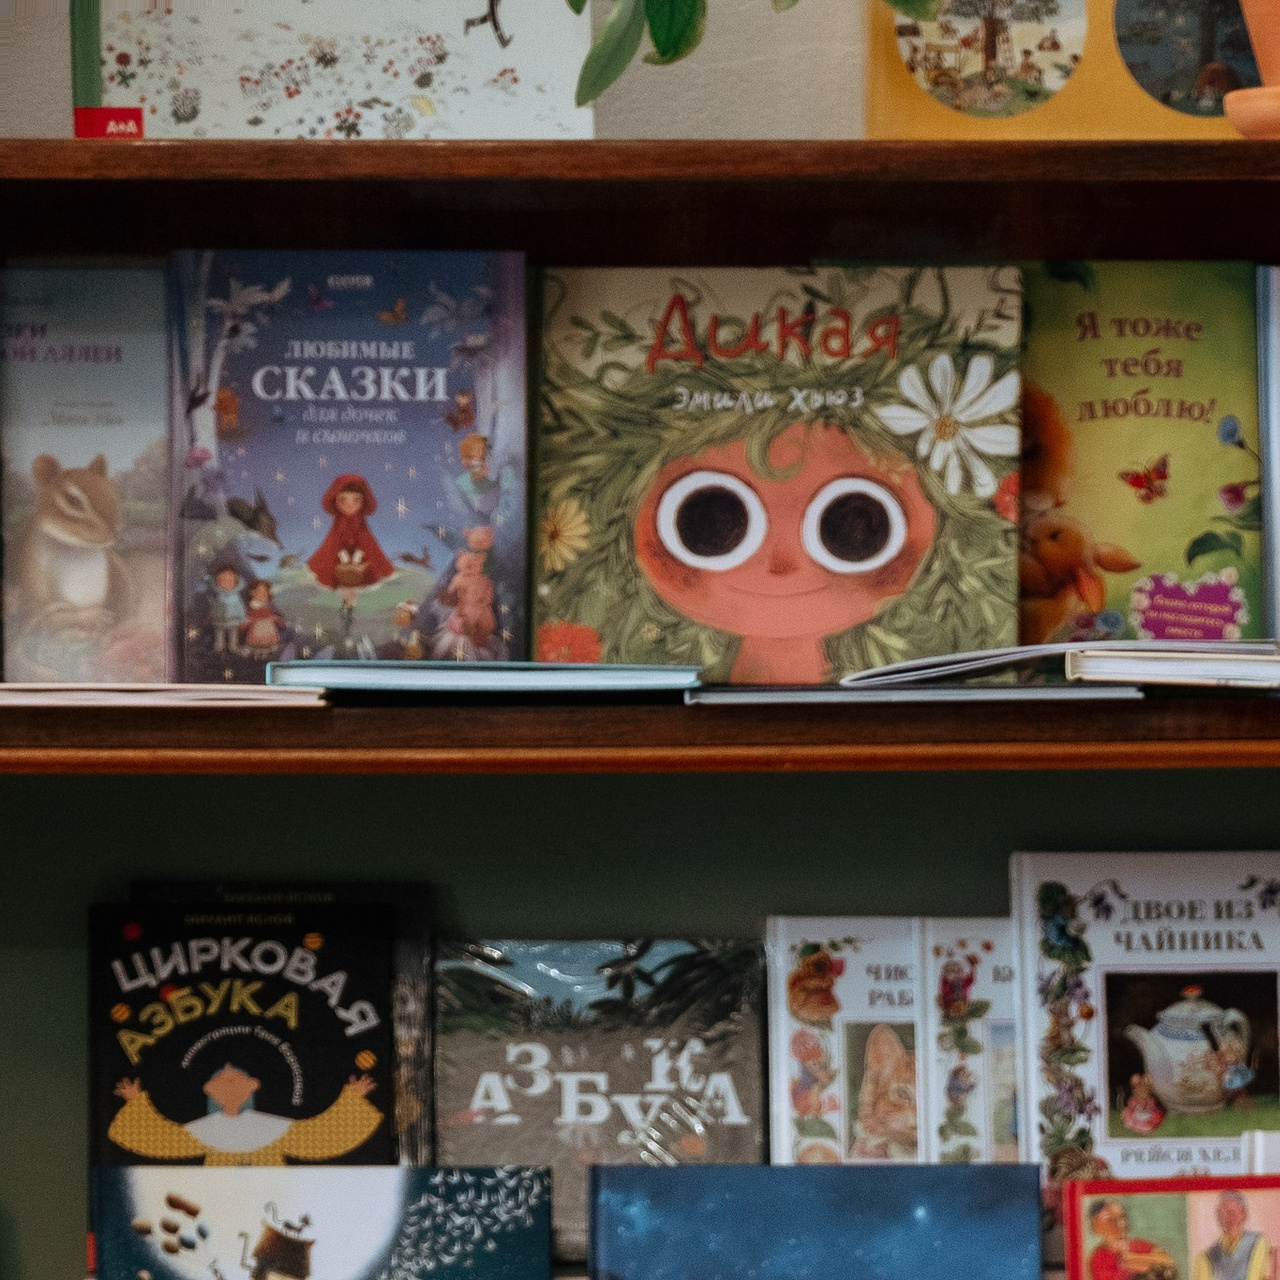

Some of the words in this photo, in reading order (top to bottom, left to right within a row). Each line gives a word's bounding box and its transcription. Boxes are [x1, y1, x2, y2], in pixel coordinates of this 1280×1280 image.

[645, 293, 899, 375] Дикая
[1076, 312, 1098, 341] Я
[1111, 315, 1204, 342] тоже
[284, 340, 416, 360] ЛЮБИМЫЕ
[1103, 348, 1184, 379] тебя
[251, 365, 449, 401] СКАЗКИ
[1077, 387, 1218, 425] люблю!
[1113, 927, 1265, 952] ЧАЙНИКА
[111, 938, 379, 1037] ЦИРКОВАЯ
[117, 979, 299, 1065] АЗБУКА
[469, 1037, 751, 1147] АЗБУКА
